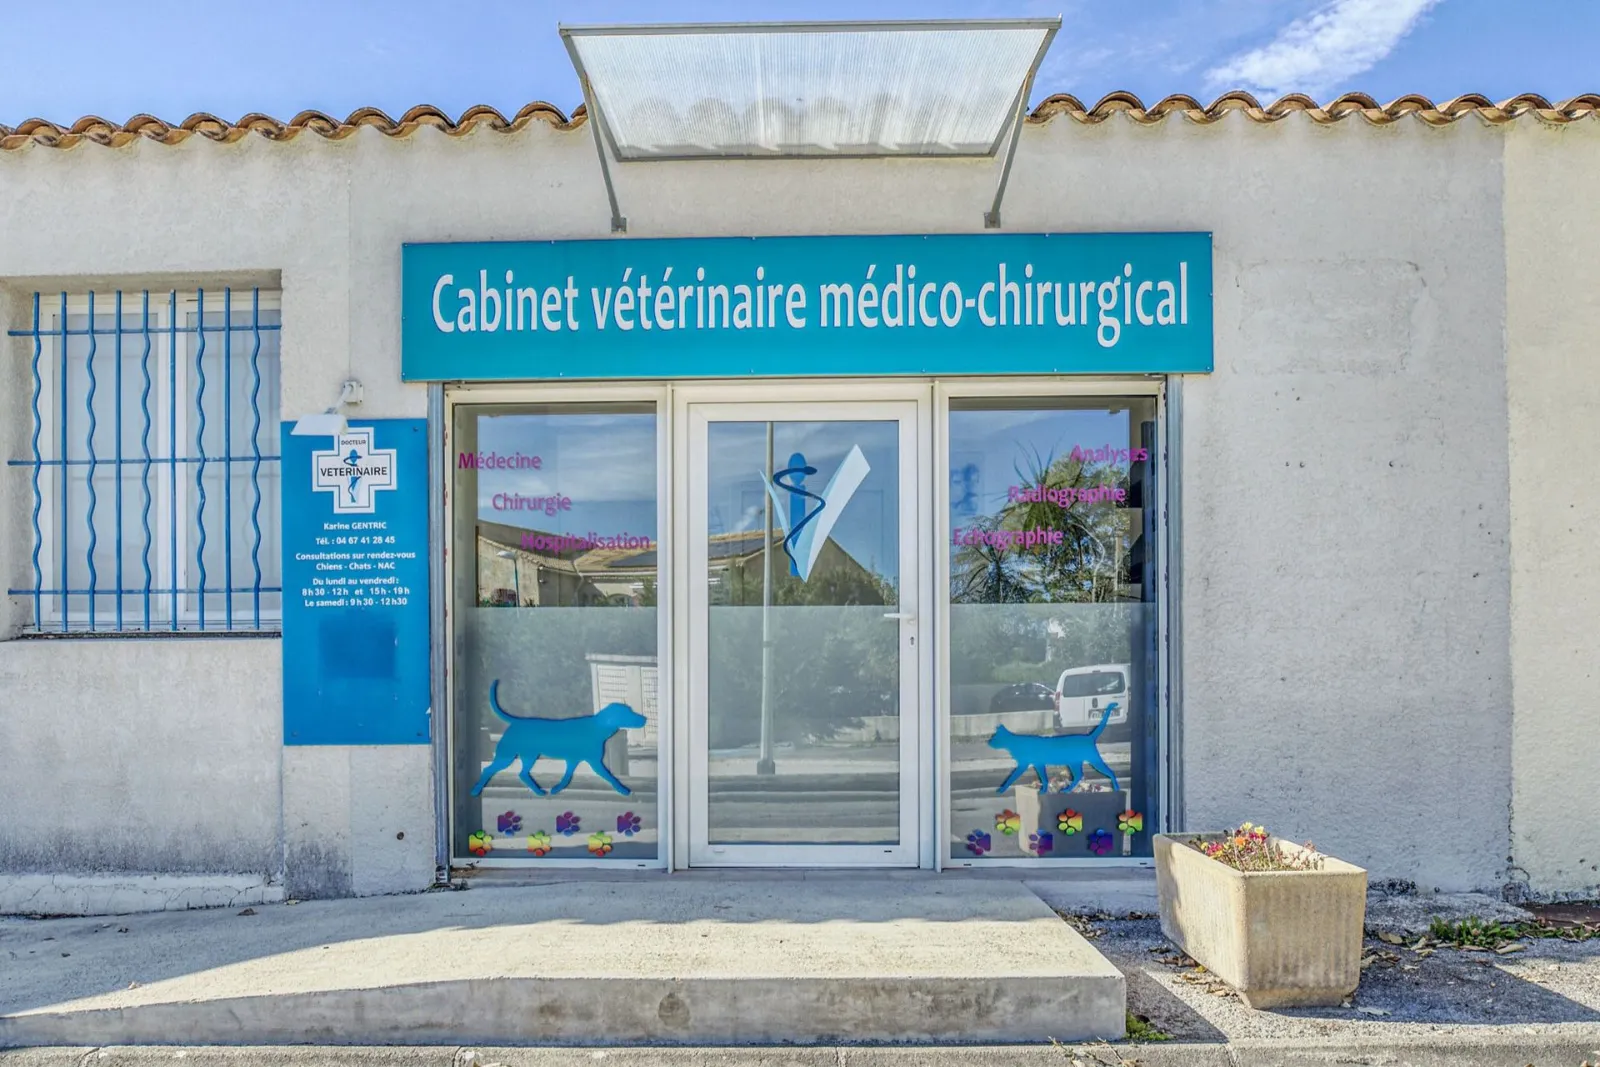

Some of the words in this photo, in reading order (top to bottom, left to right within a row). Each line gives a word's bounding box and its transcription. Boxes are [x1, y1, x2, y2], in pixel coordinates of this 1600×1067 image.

[432, 269, 579, 333] Cabinet
[591, 266, 807, 331] vétérinaire
[819, 261, 1188, 348] médico-chirurgical
[458, 451, 542, 470] Médecine
[1070, 443, 1148, 467] Analyses
[320, 466, 388, 477] VETERINAIRE
[1008, 483, 1127, 508] Radiographie
[492, 492, 572, 517] Chirurgie
[323, 522, 350, 531] Karine
[351, 521, 387, 530] GENTRIC
[336, 536, 347, 545] 04
[348, 536, 359, 545] 67
[360, 536, 370, 544] 41
[372, 536, 383, 544] 28
[384, 535, 396, 544] 45
[520, 530, 651, 555] Hospitalisation
[952, 526, 1064, 550] Echographie
[295, 552, 351, 560] Consultations
[366, 550, 416, 559] rendez-vous
[316, 562, 343, 571] Chiens
[349, 562, 372, 570] Chats
[377, 562, 396, 570] NAC
[312, 577, 324, 586] Du
[325, 577, 346, 586] lundi
[354, 588, 364, 596] et
[304, 599, 315, 608] Le
